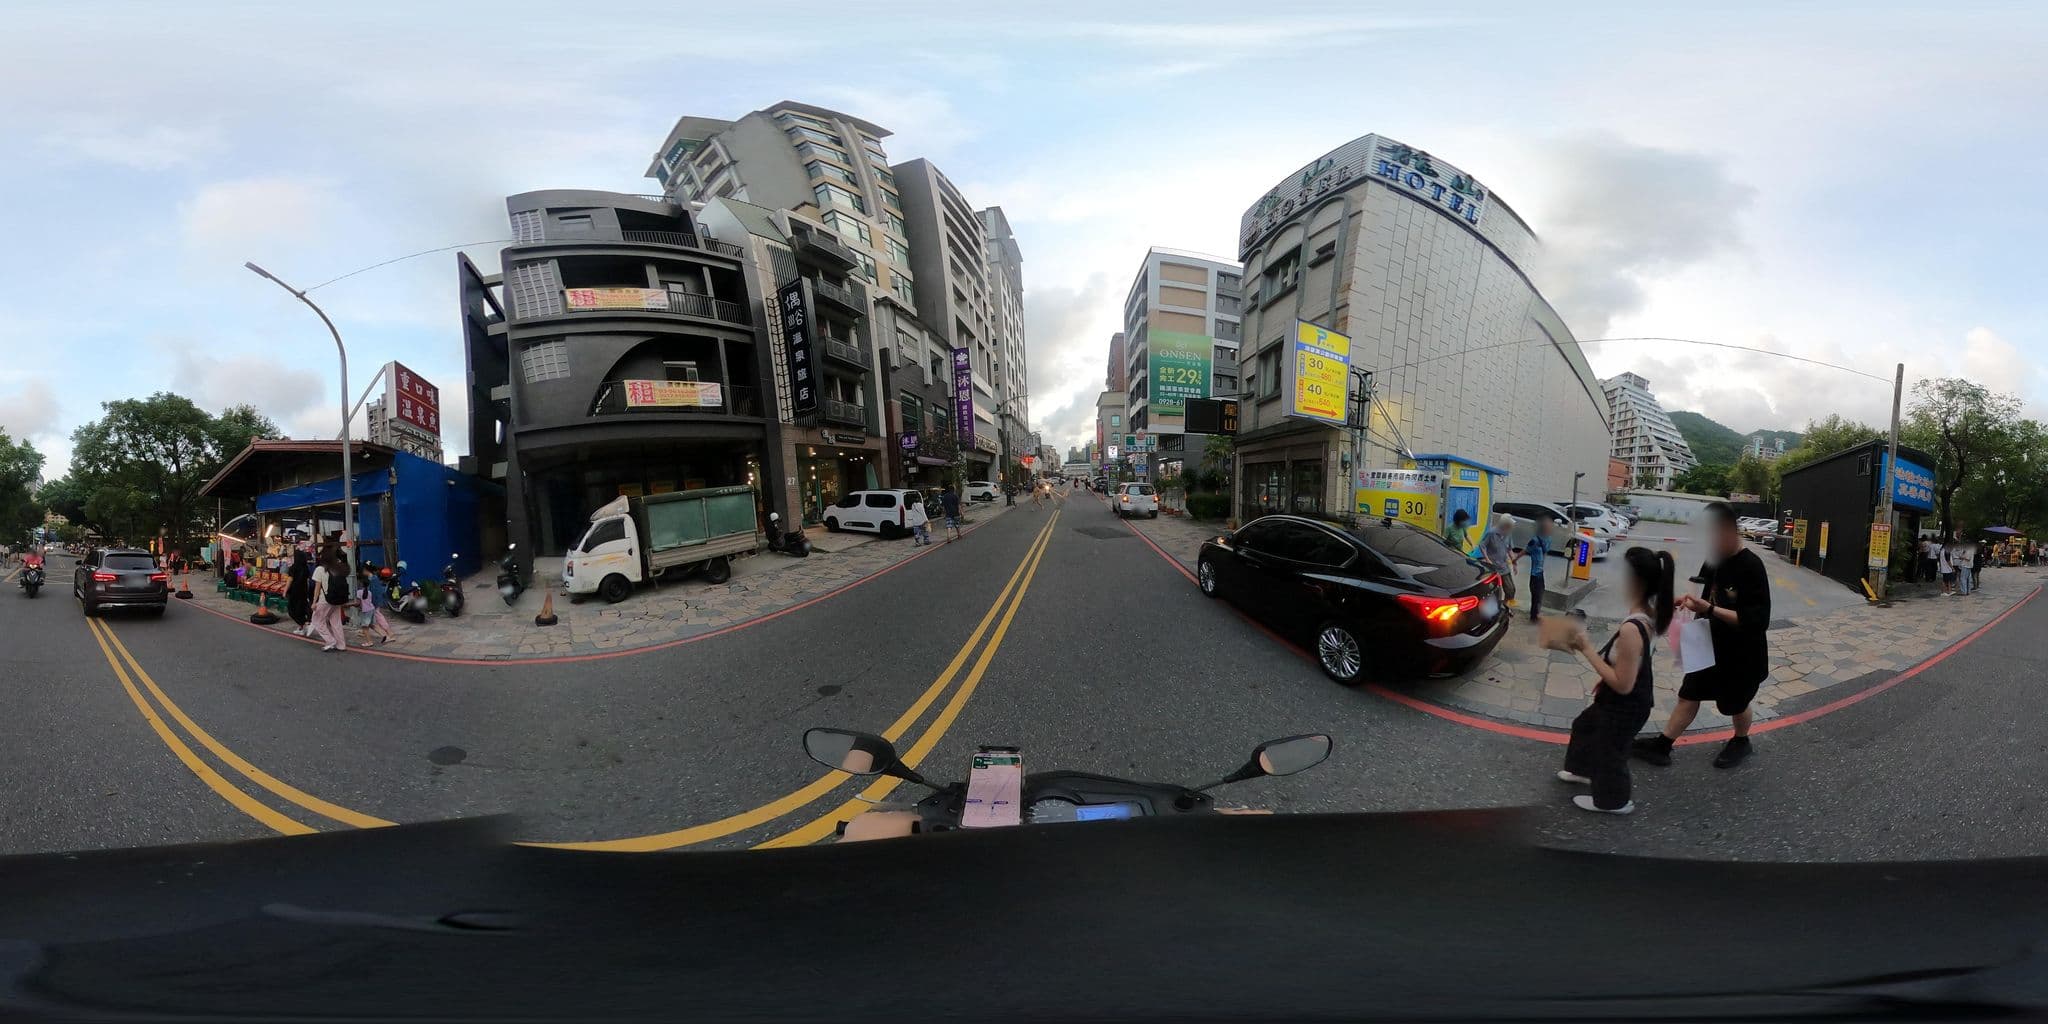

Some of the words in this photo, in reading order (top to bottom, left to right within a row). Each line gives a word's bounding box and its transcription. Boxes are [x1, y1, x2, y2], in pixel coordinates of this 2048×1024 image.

[1266, 166, 1352, 230] HOTEL
[1378, 160, 1479, 224] HOTEL
[1160, 349, 1201, 361] ONSEN
[1308, 357, 1324, 370] 30
[400, 371, 436, 405] 重口味
[629, 382, 657, 404] 租
[958, 376, 971, 402] 沐恩
[1307, 383, 1322, 396] 40
[402, 399, 437, 431] 溫泉魚
[787, 477, 796, 486] 27
[1405, 500, 1424, 515] 30
